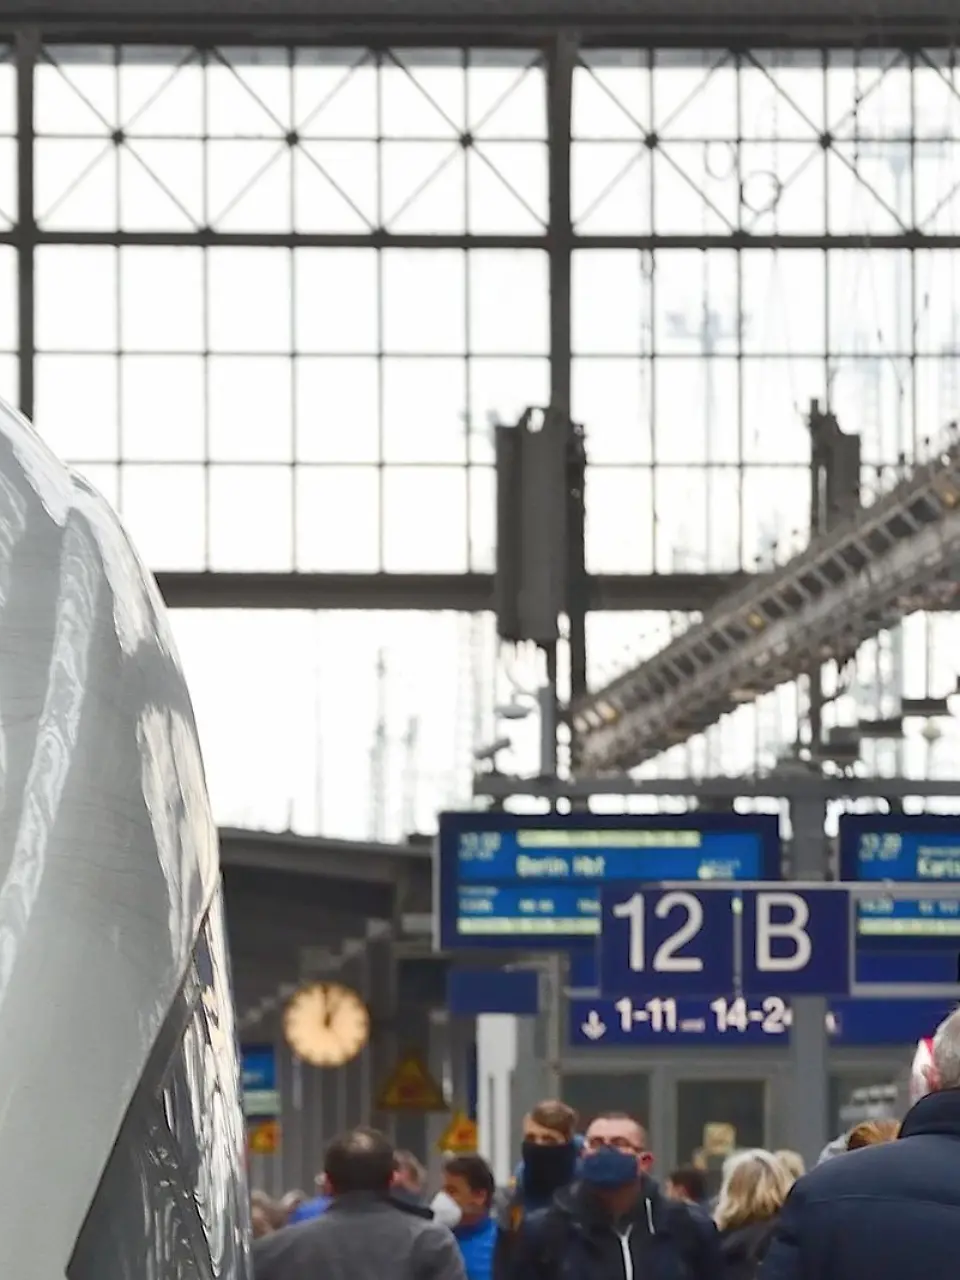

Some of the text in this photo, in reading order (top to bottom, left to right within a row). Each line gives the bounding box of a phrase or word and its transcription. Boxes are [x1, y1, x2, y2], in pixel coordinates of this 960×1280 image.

[613, 891, 812, 972] 12 B
[615, 996, 678, 1033] 1-11
